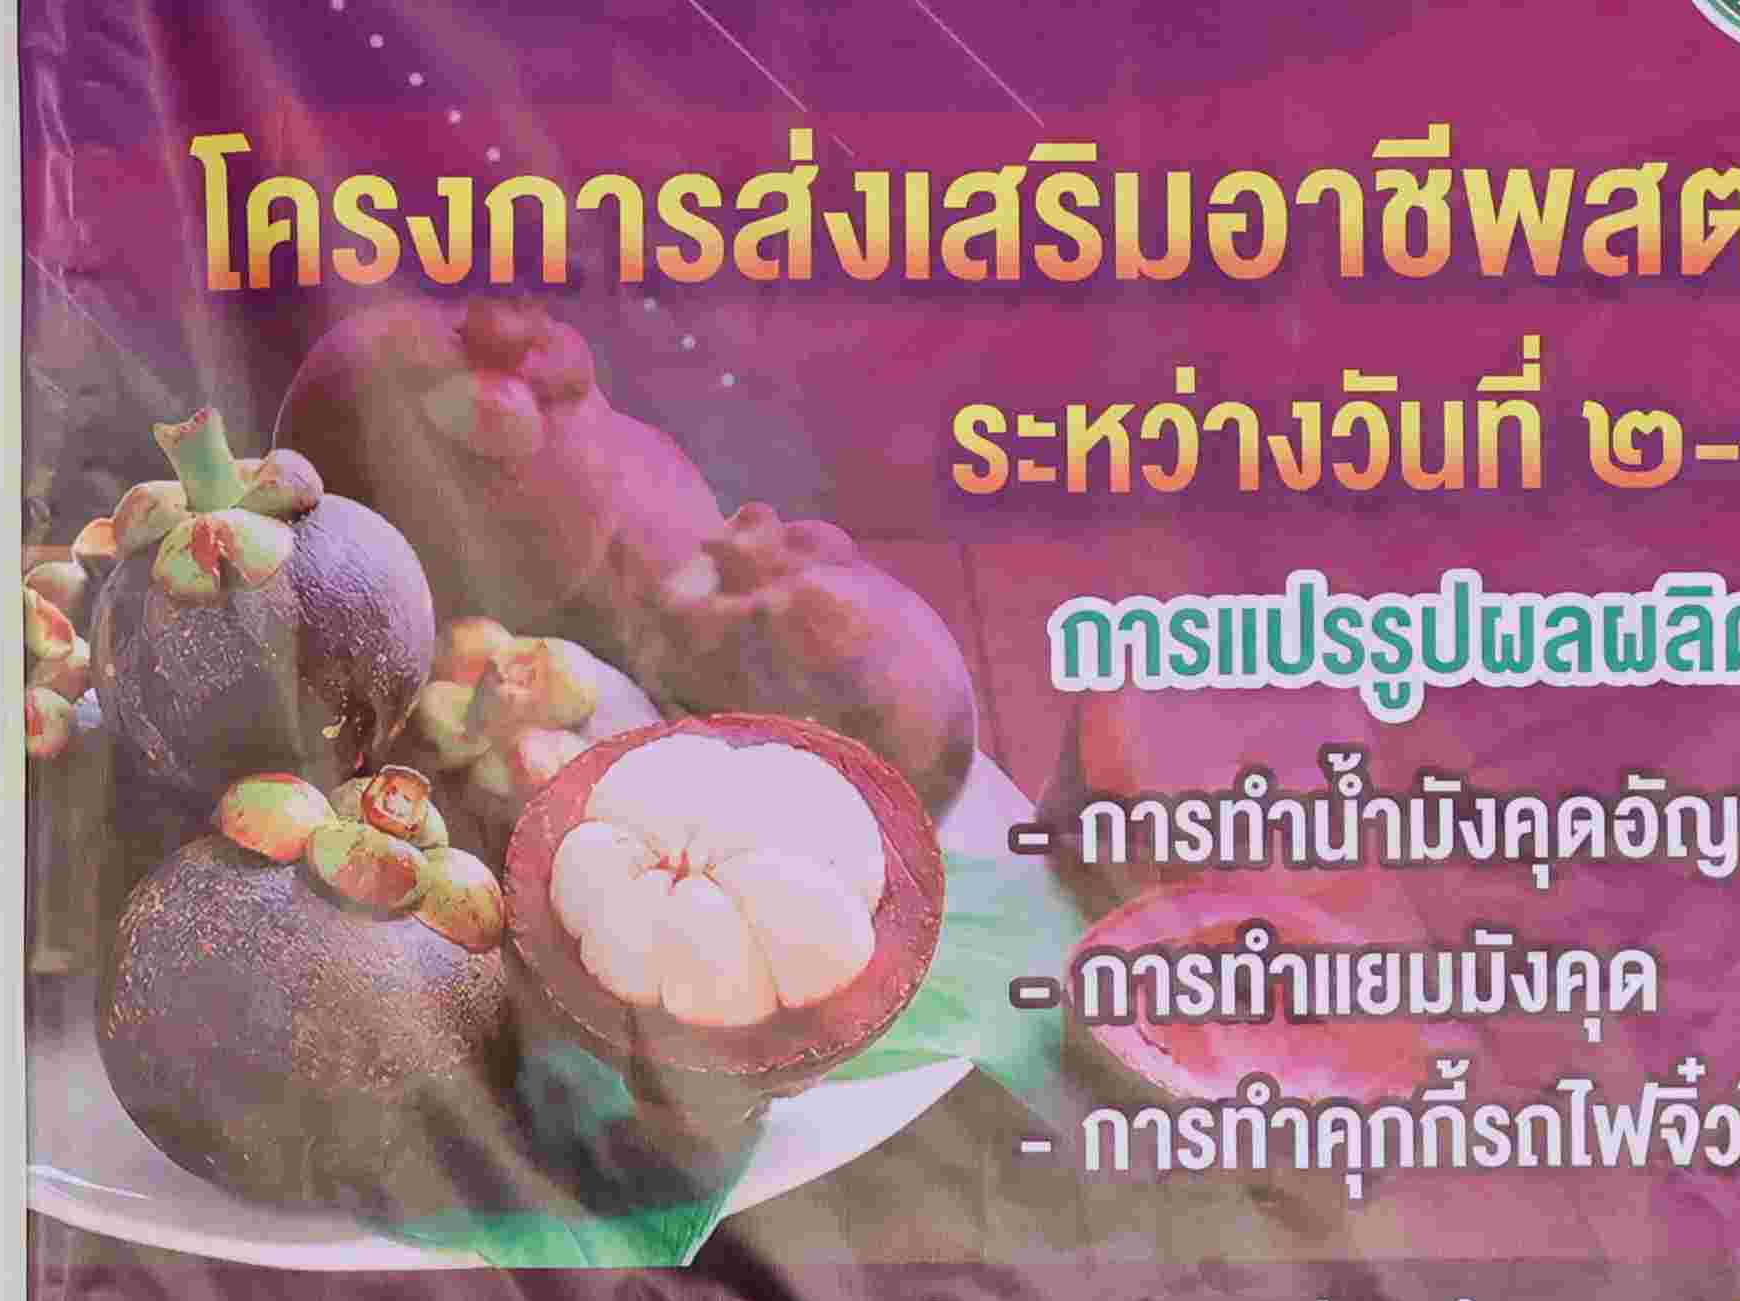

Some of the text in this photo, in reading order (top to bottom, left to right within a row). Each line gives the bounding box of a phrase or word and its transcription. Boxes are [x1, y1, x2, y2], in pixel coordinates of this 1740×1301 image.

[952, 335, 1542, 492] ระหว่างวันที่
[1080, 928, 1658, 1042] การทำแยมมังคุด
